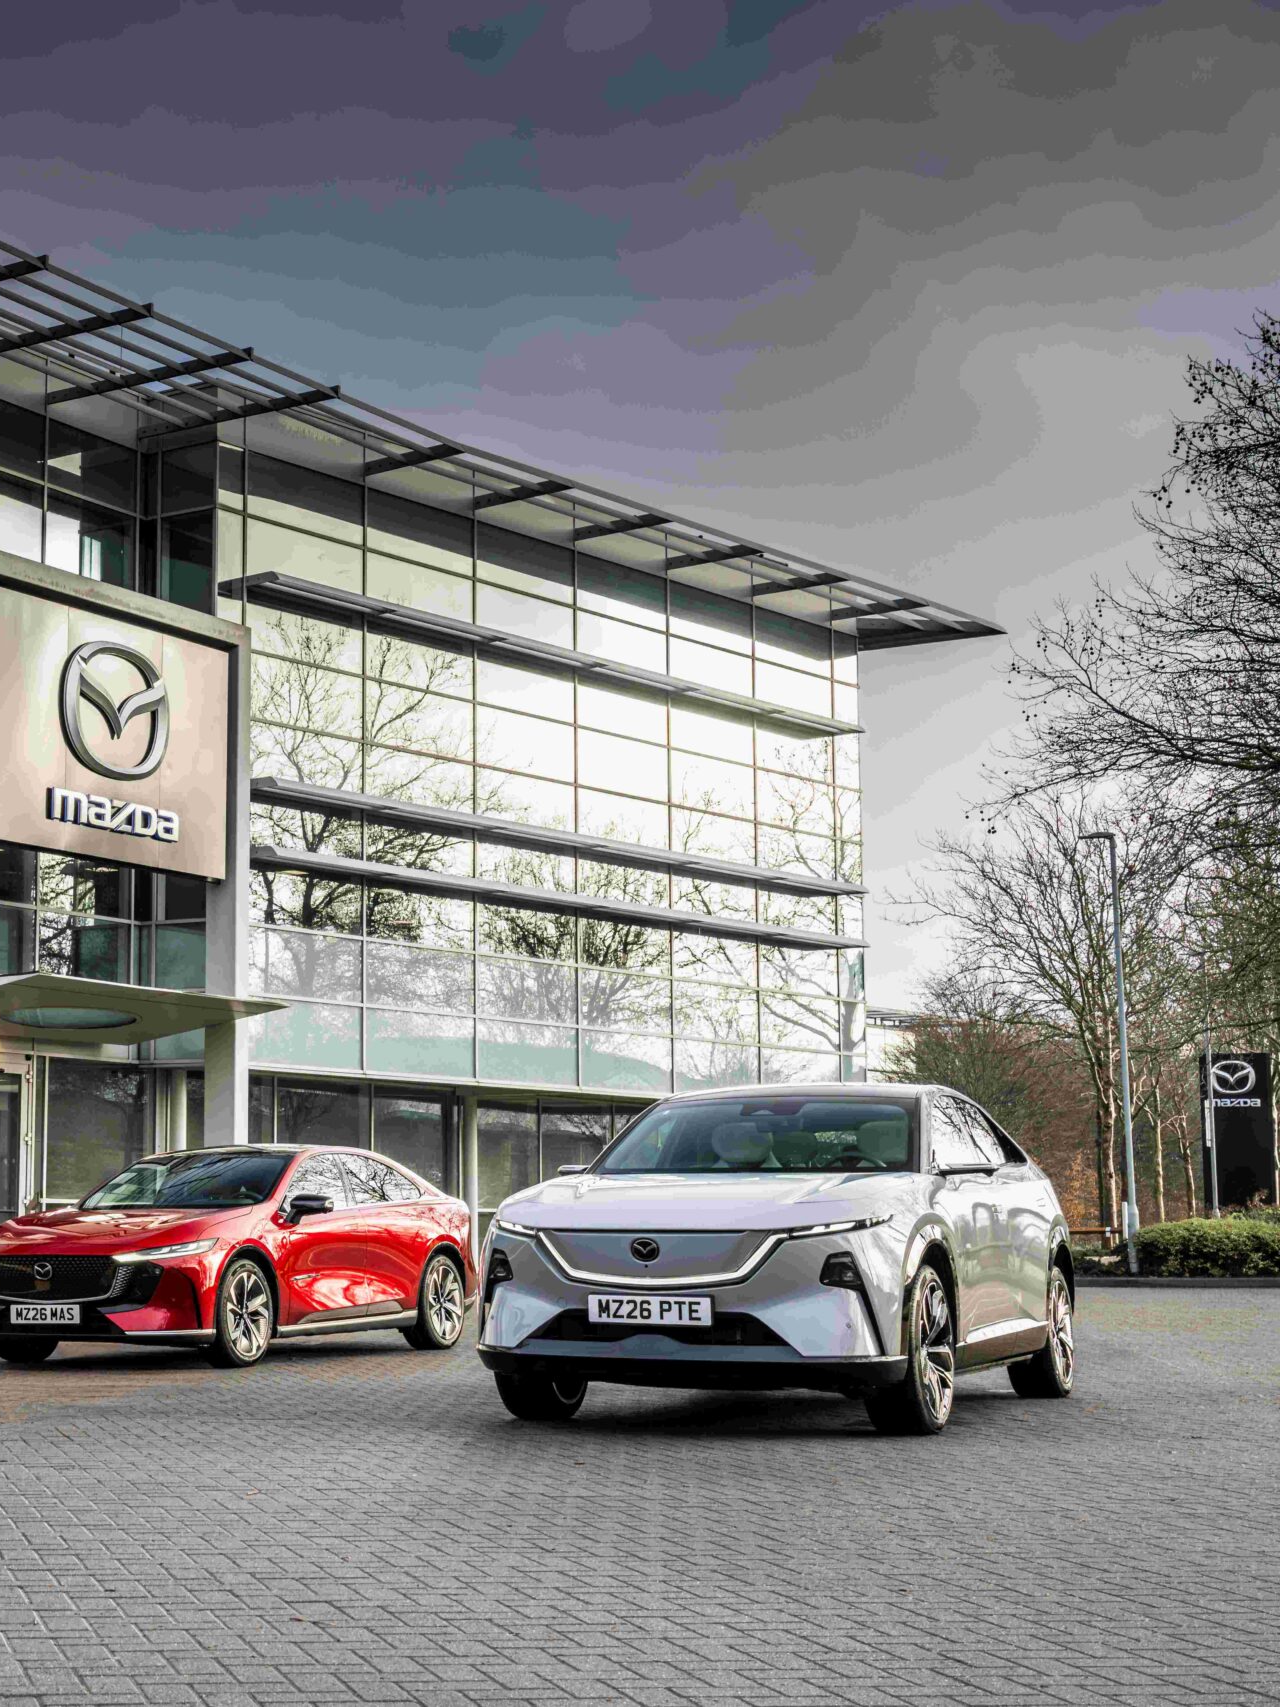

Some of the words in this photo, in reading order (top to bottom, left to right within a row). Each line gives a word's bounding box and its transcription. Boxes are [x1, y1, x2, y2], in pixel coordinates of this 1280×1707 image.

[46, 787, 179, 842] mazda
[15, 1307, 47, 1321] MZ26
[50, 1307, 74, 1321] MAS
[598, 1299, 652, 1320] MZ26
[659, 1301, 701, 1321] PTE
